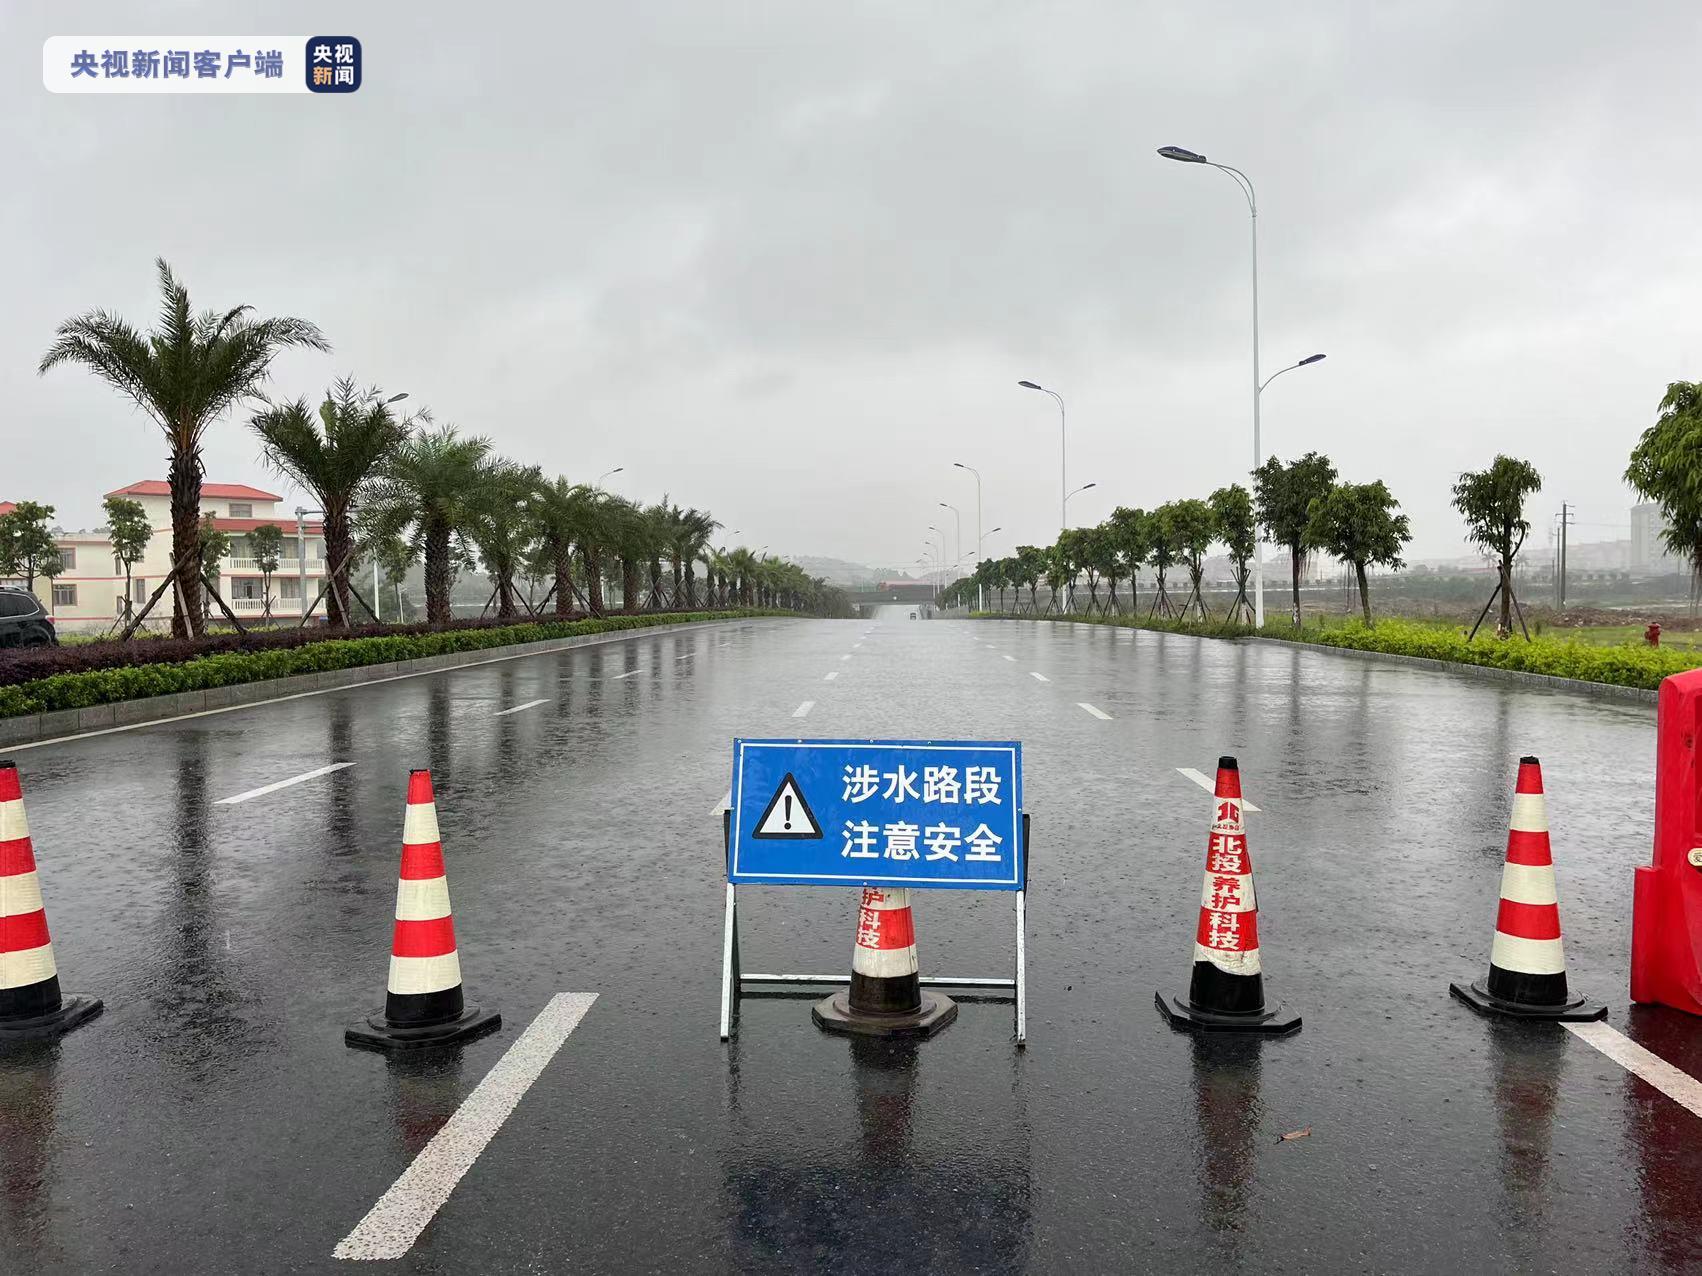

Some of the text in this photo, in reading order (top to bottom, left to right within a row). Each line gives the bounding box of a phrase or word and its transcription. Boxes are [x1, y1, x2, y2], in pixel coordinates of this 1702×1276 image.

[841, 764, 1003, 806] 涉水路段
[840, 820, 1003, 862] 注意安全
